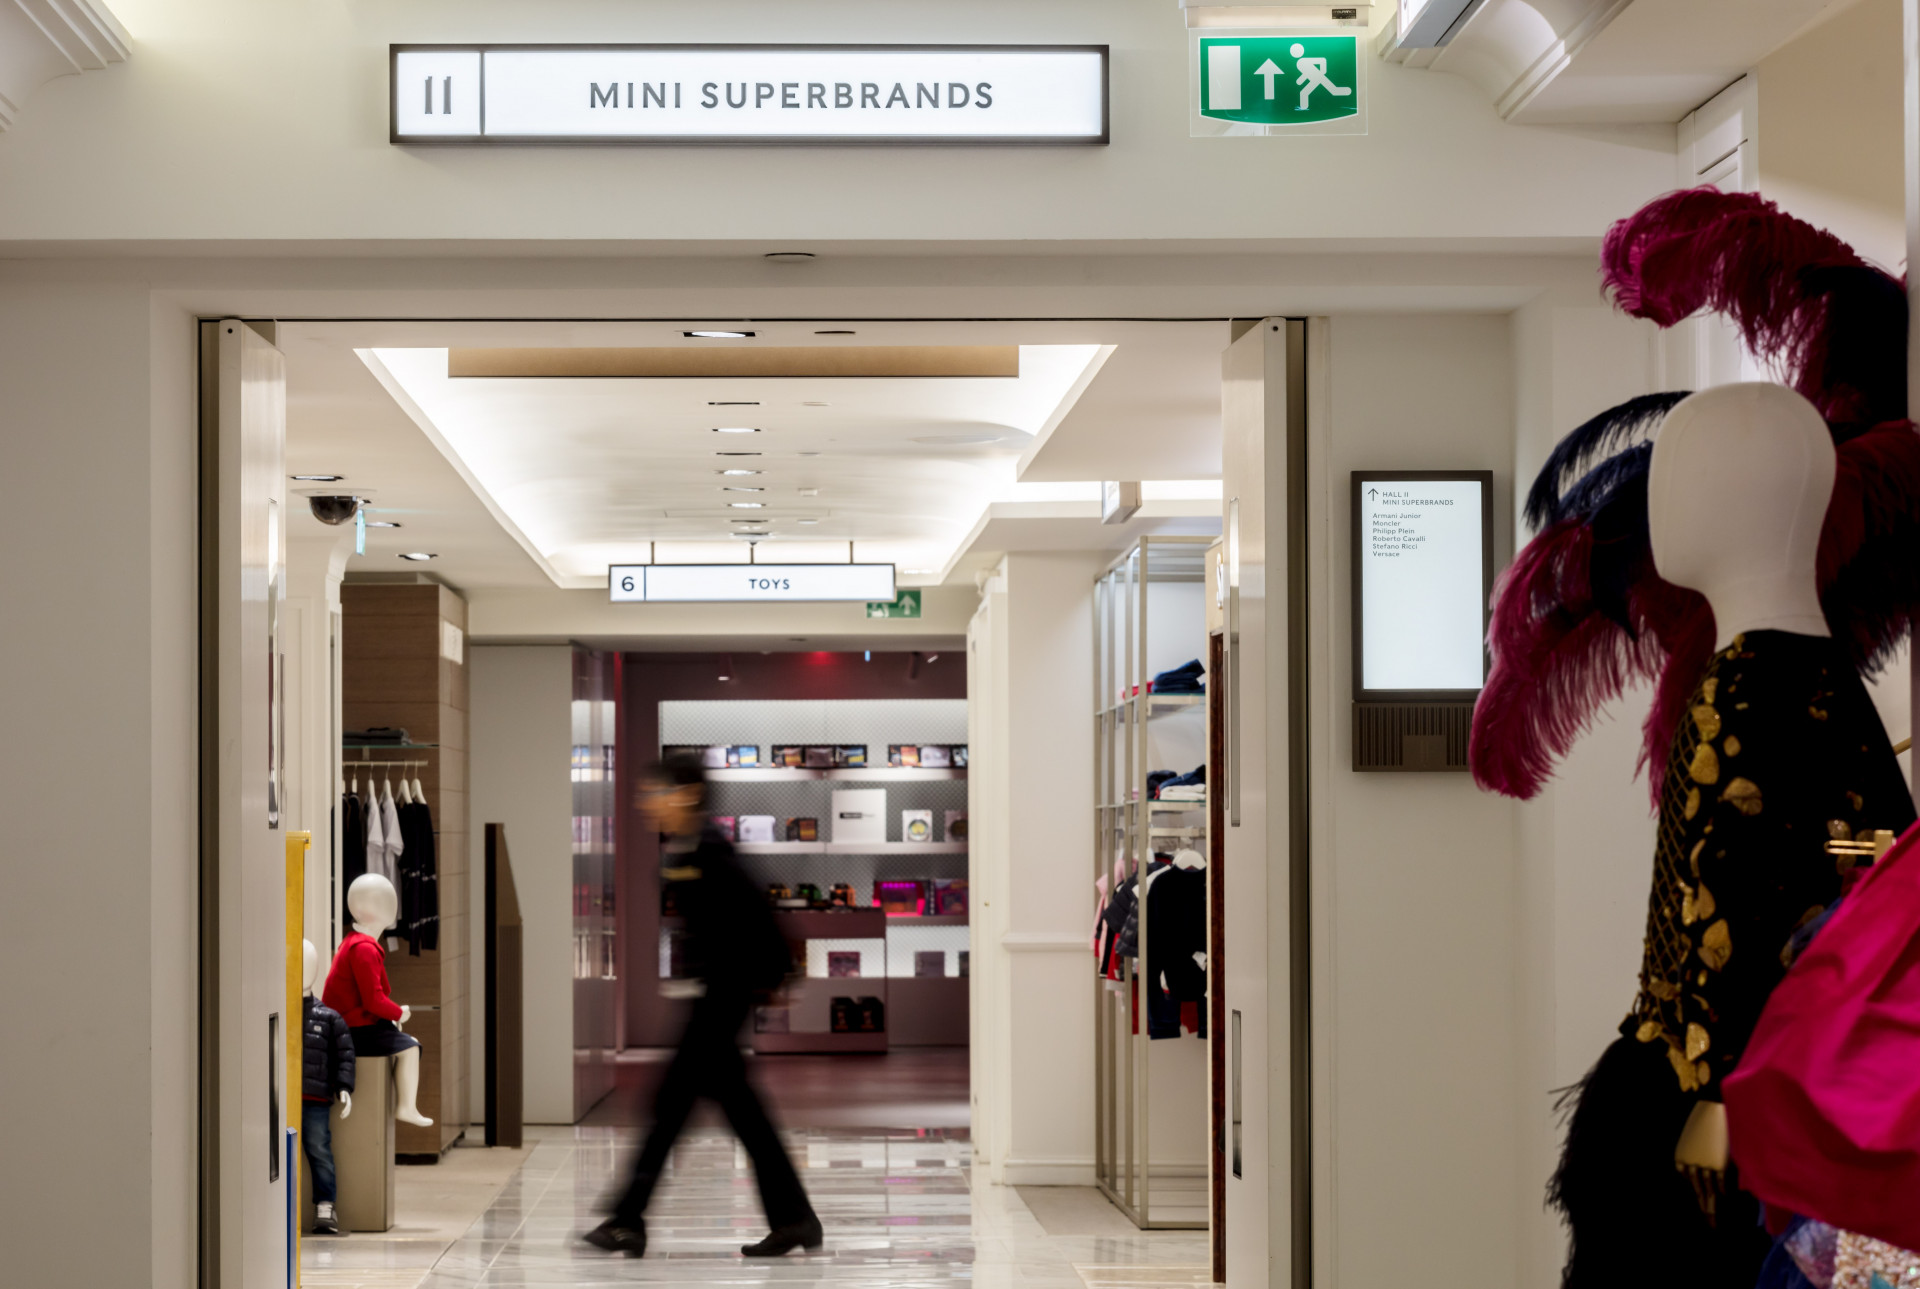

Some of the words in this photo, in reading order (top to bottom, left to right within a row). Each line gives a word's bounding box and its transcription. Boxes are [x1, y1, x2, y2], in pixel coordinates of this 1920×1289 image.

[590, 82, 681, 109] MINI
[700, 82, 993, 109] SUPERBRANDS
[1372, 527, 1396, 535] Philipp
[621, 576, 635, 592] 6
[749, 578, 790, 590] TOYS
